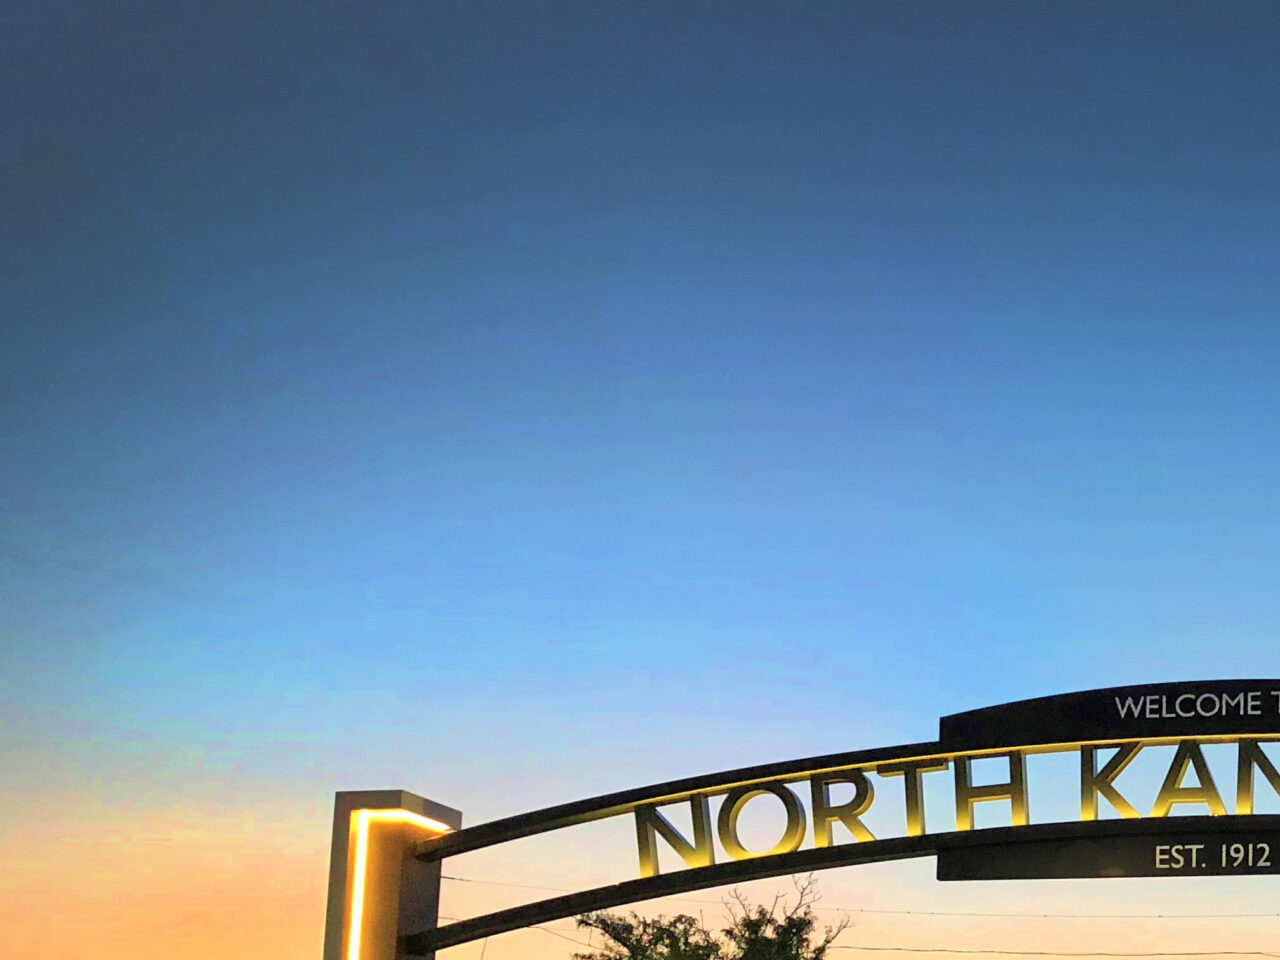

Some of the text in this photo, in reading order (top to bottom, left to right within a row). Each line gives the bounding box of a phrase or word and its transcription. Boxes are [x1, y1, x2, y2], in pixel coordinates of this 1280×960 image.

[1114, 691, 1262, 719] WELCOME
[635, 749, 1030, 878] NORTH
[1155, 843, 1272, 869] EST. 1912
